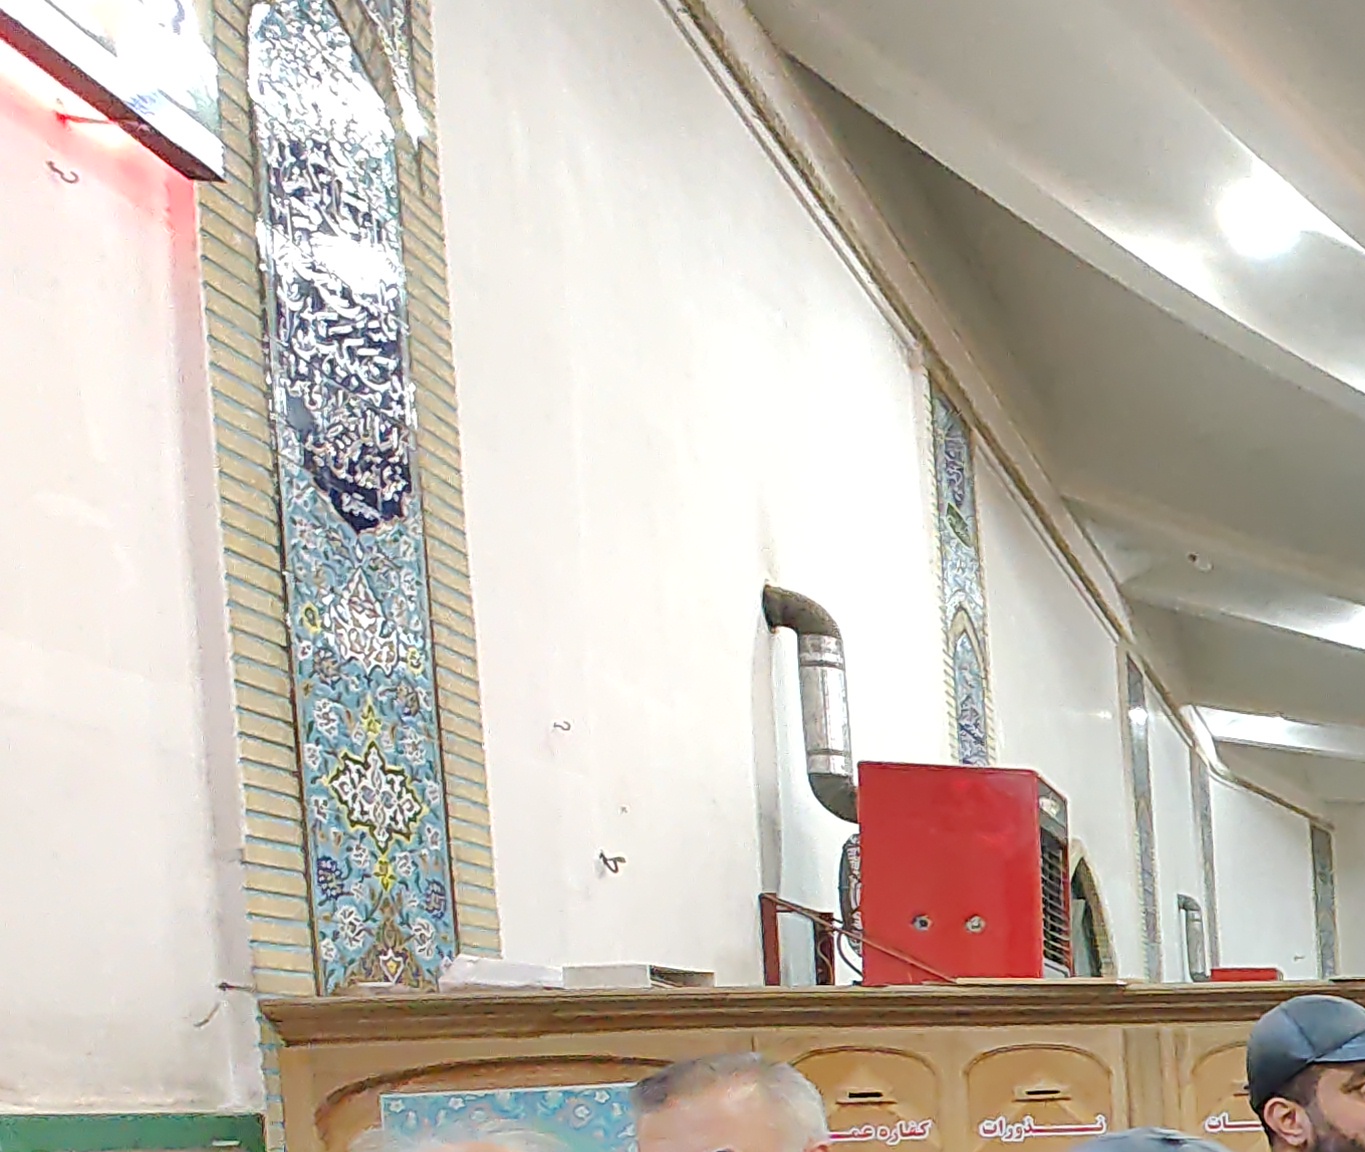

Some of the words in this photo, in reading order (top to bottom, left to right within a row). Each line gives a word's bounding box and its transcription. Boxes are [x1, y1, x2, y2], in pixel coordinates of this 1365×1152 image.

[828, 1123, 876, 1142] عم
[878, 1119, 932, 1145] کفاره
[978, 1114, 1107, 1142] نذورات
